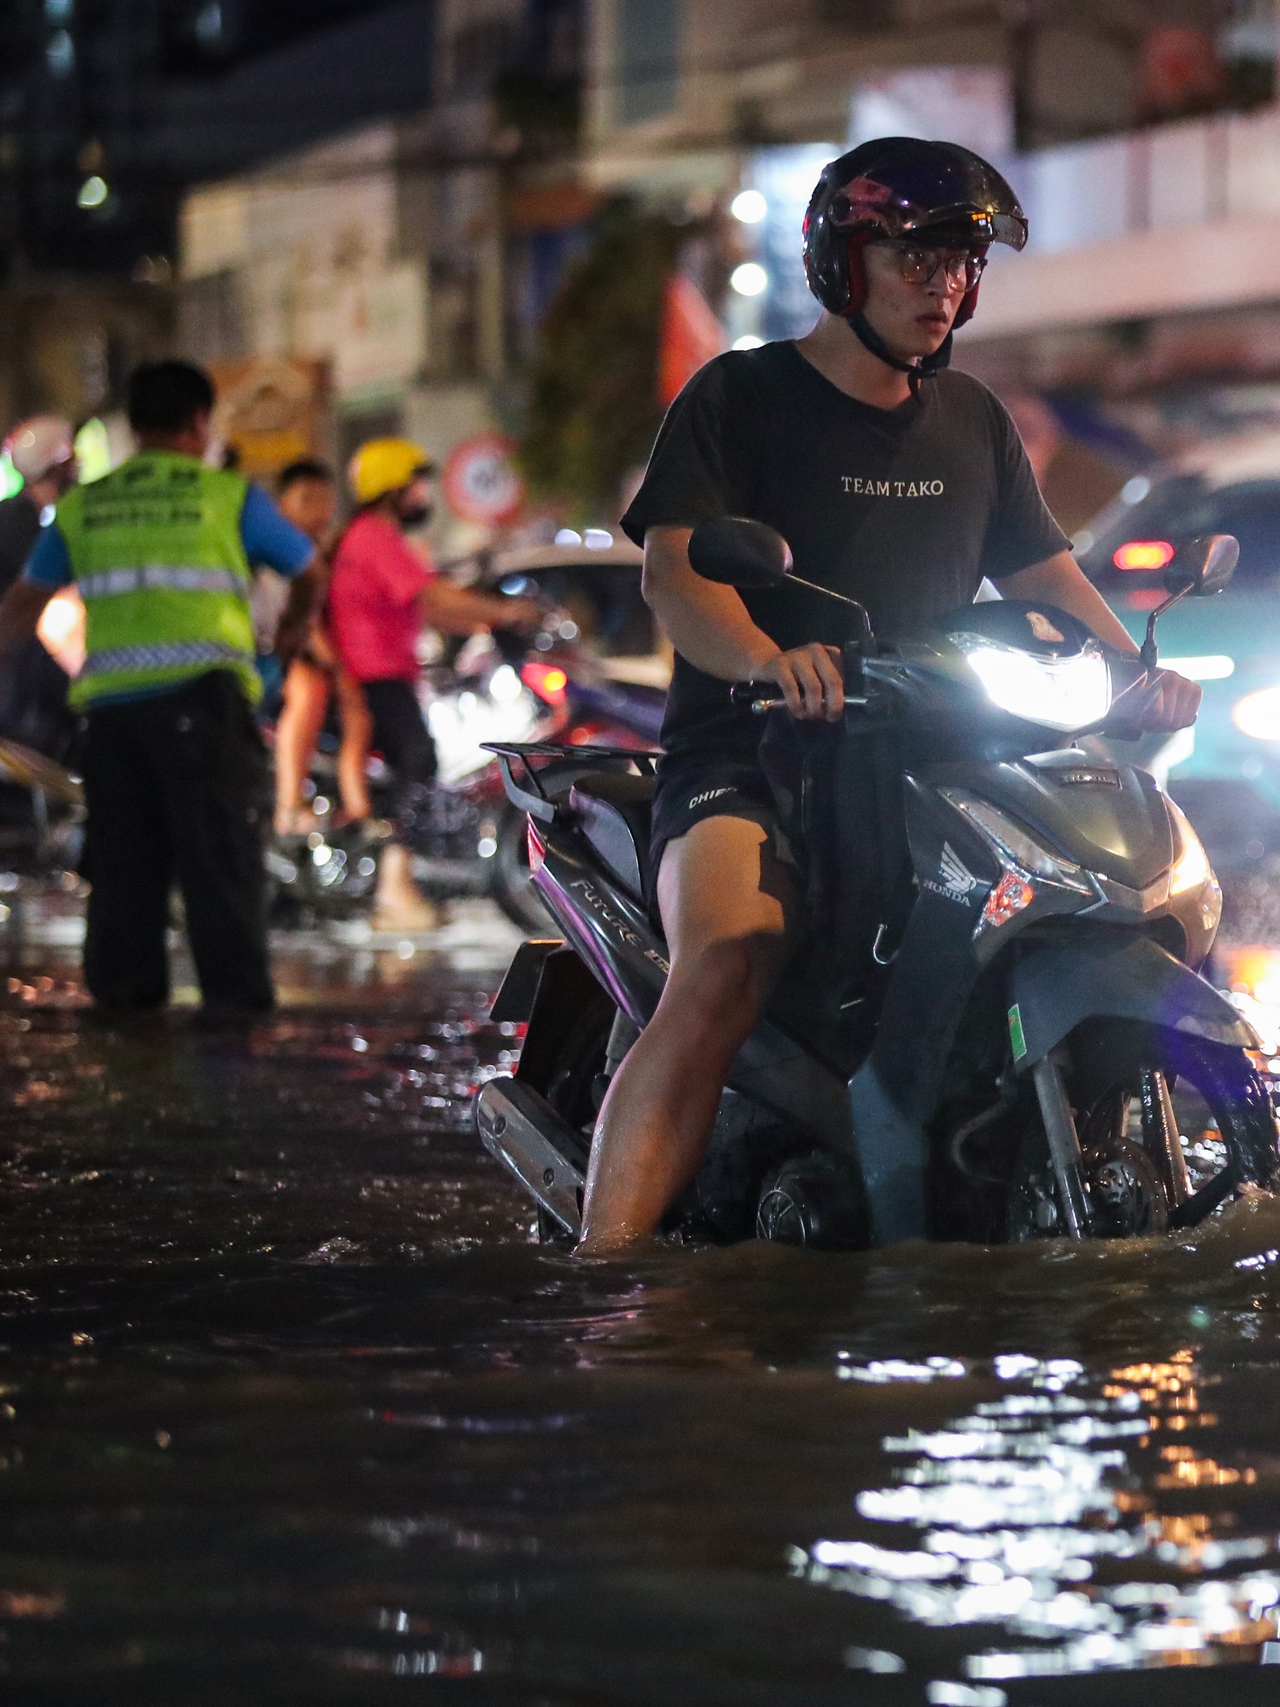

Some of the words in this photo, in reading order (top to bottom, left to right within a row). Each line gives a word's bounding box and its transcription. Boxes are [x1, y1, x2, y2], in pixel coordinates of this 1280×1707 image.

[841, 476, 890, 497] TEAM
[894, 479, 944, 497] TAKO
[923, 880, 971, 907] HONDA
